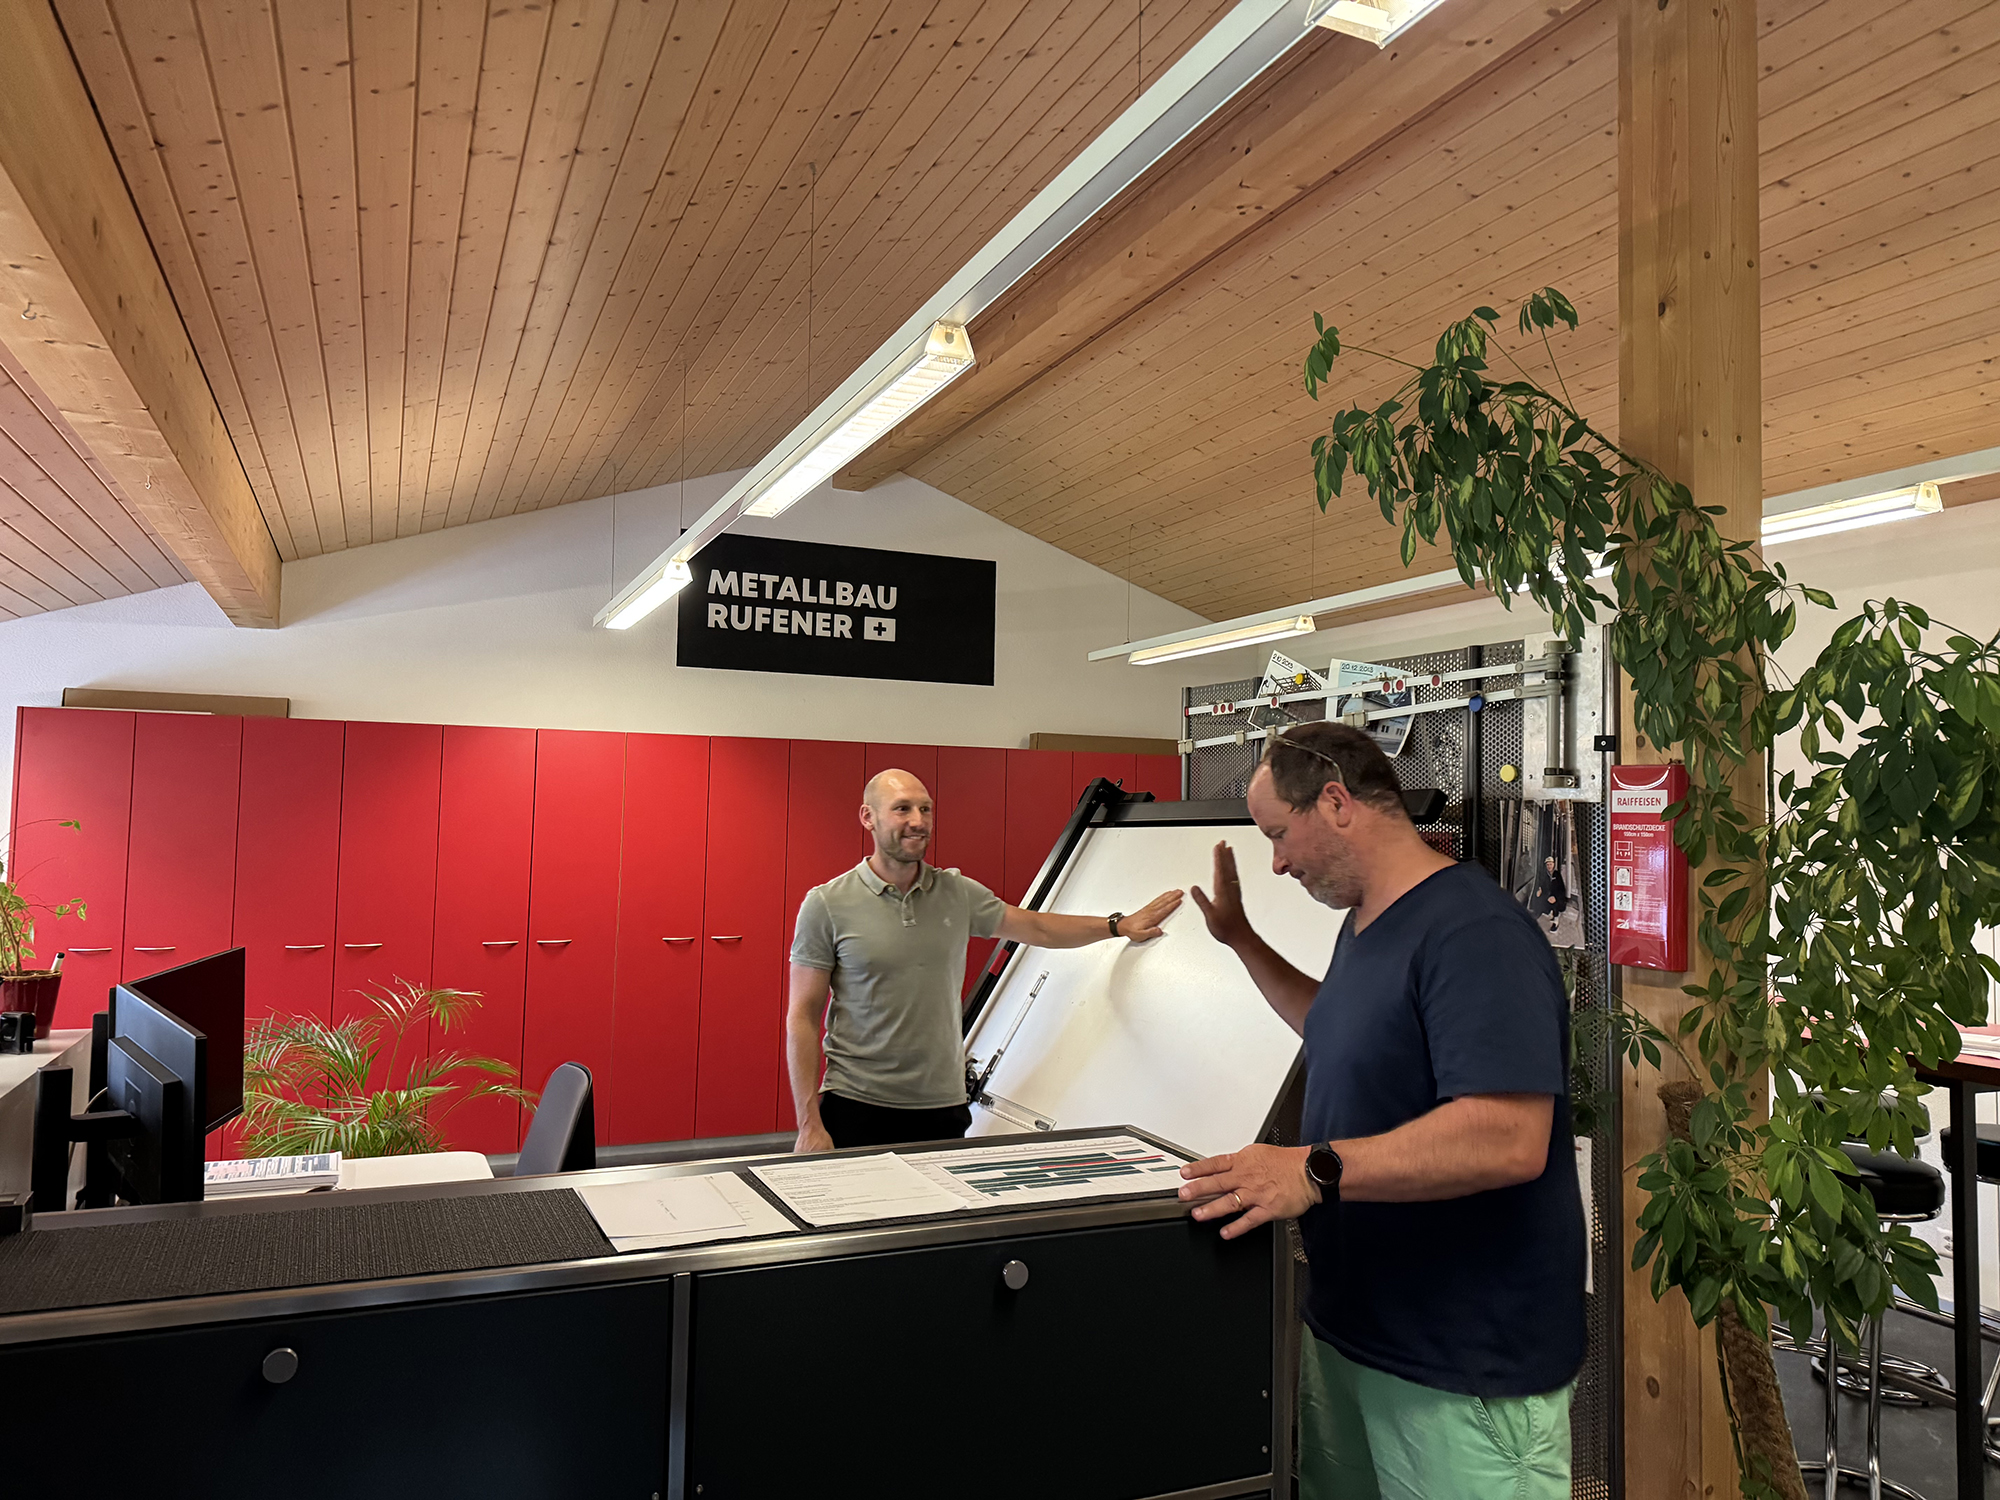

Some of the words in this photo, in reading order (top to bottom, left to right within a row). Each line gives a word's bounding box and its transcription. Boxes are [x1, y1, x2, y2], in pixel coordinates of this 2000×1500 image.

[707, 569, 897, 610] METALLBAU
[707, 602, 853, 639] RUFENER
[1617, 797, 1661, 806] RAIFFEISEN
